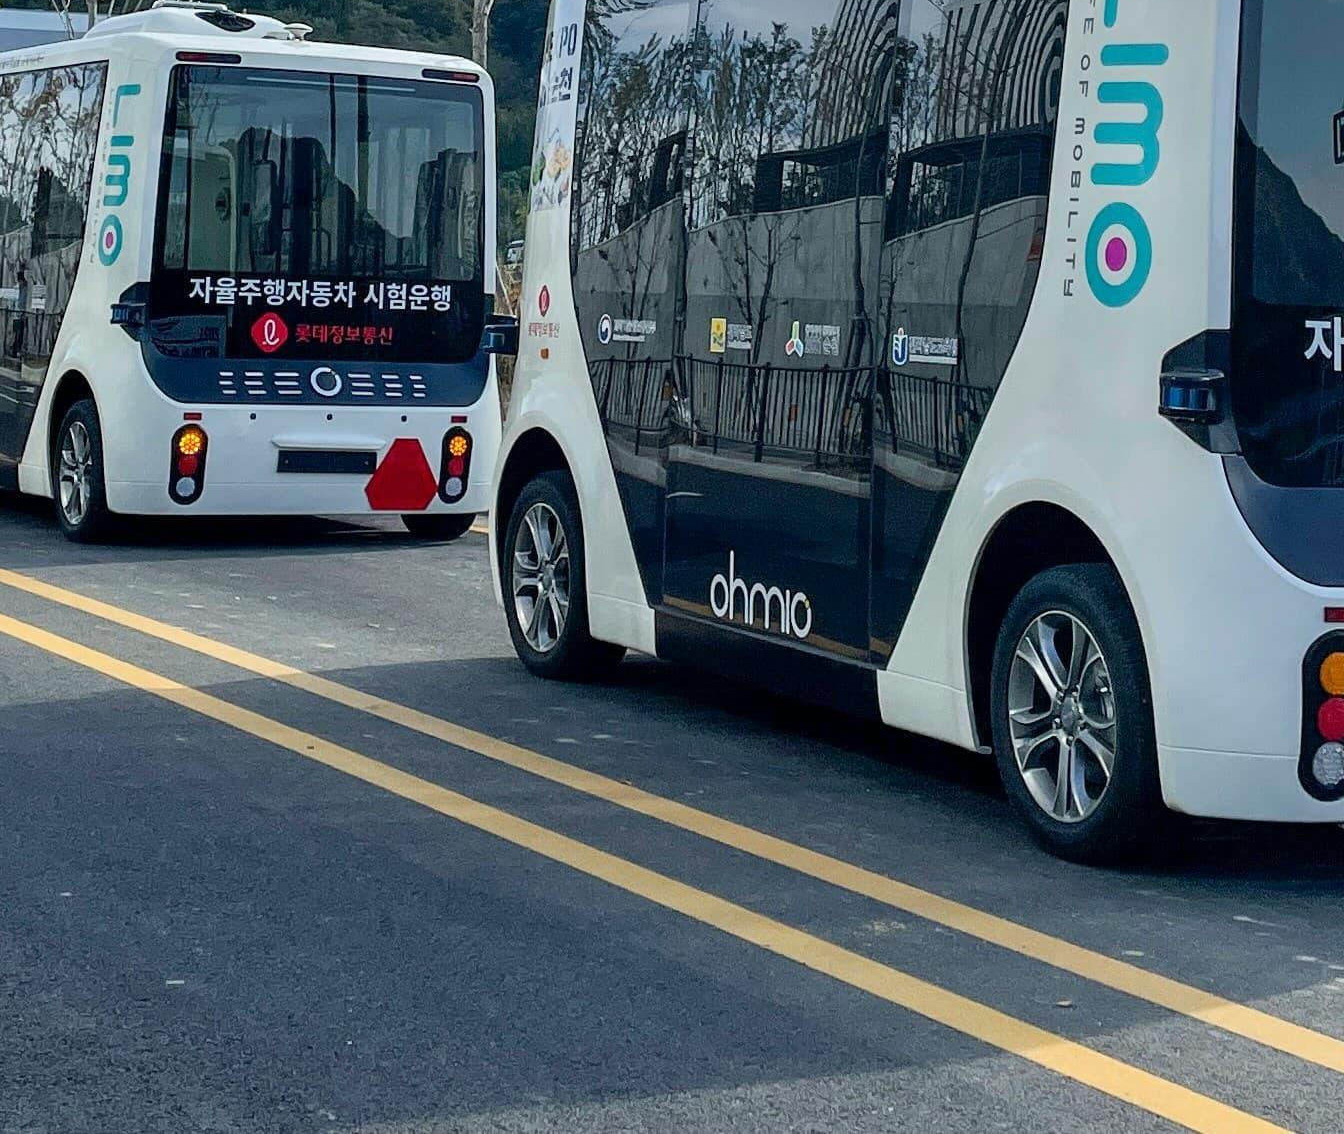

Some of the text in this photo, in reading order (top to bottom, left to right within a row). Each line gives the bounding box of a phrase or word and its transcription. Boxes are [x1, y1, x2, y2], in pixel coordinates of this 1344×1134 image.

[1078, 53, 1090, 98] OF
[188, 276, 452, 312] 자율주행자동차 시험운행
[294, 323, 394, 346] 롯데정보통신
[709, 549, 813, 639] ohmio
